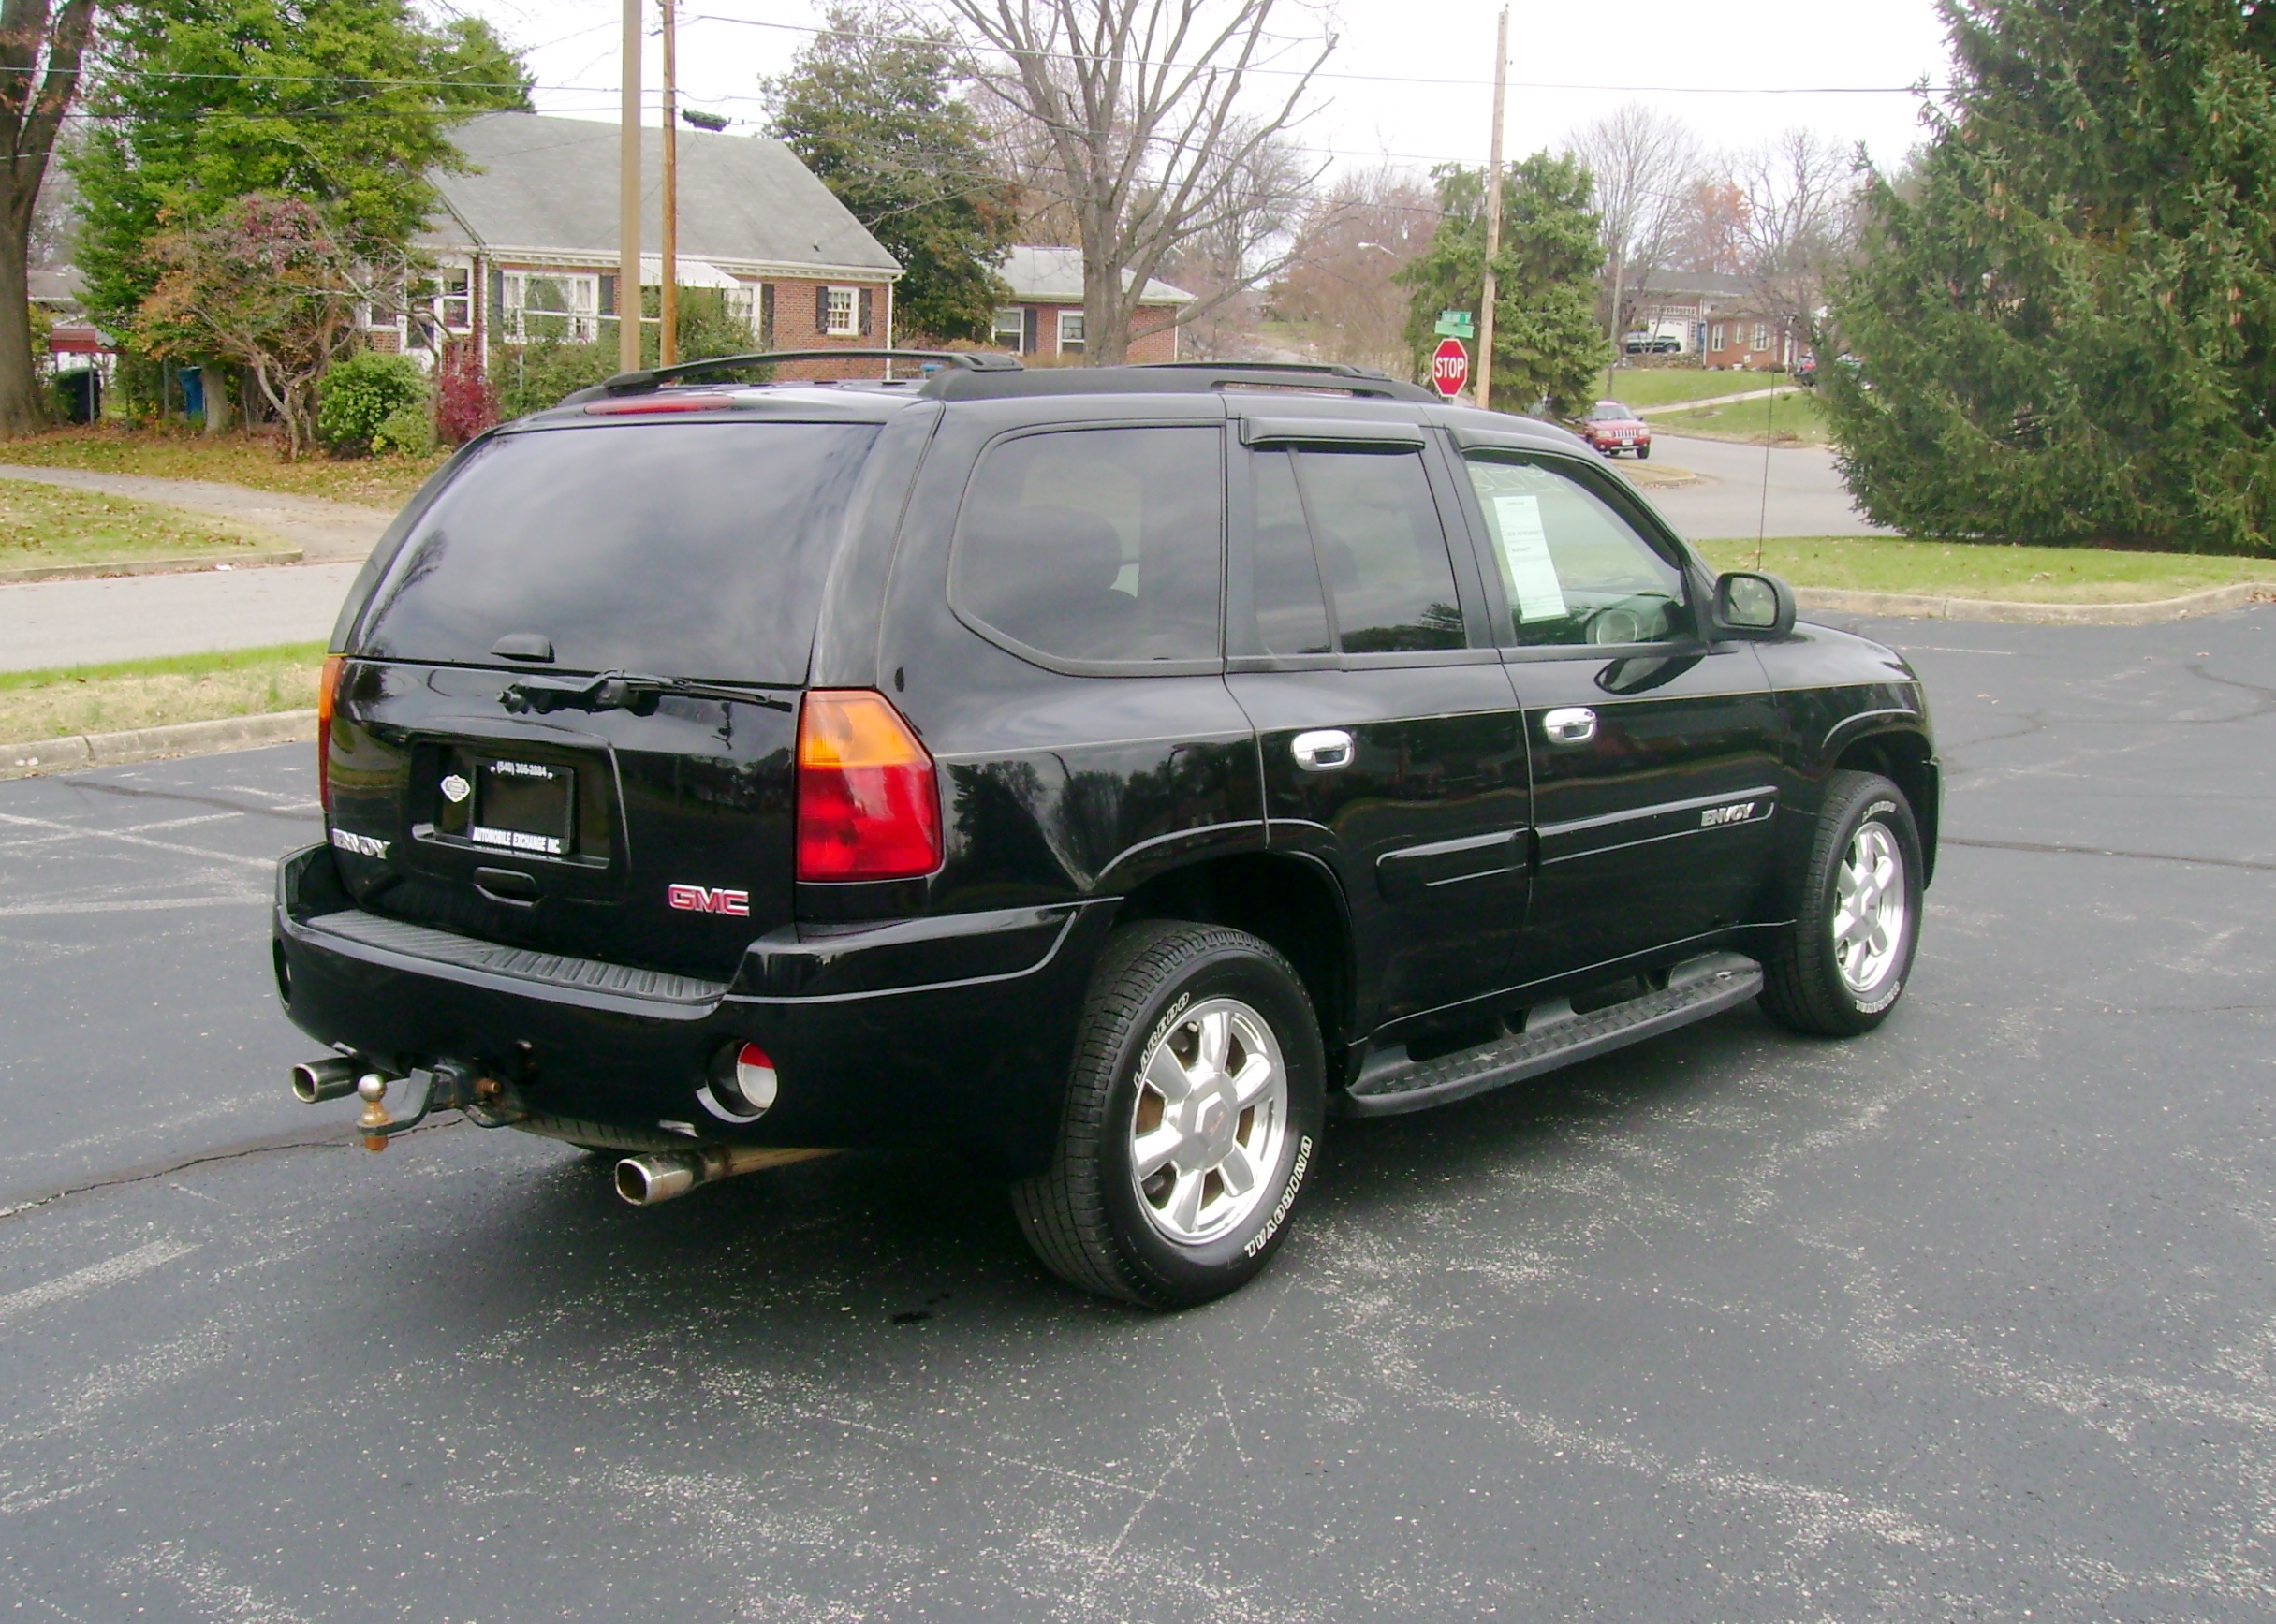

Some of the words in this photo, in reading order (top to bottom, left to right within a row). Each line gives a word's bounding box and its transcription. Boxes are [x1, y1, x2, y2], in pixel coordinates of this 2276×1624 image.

[1435, 357, 1465, 379] STOP
[1701, 802, 1755, 827] ENVOY
[331, 827, 391, 860] ENVOY
[472, 827, 512, 847] AUTOMOBILE
[512, 832, 547, 852] EXCHANGE
[668, 884, 750, 917] GMC
[1133, 991, 1190, 1090] LAREDO
[1243, 1134, 1313, 1259] UNIROYAL
